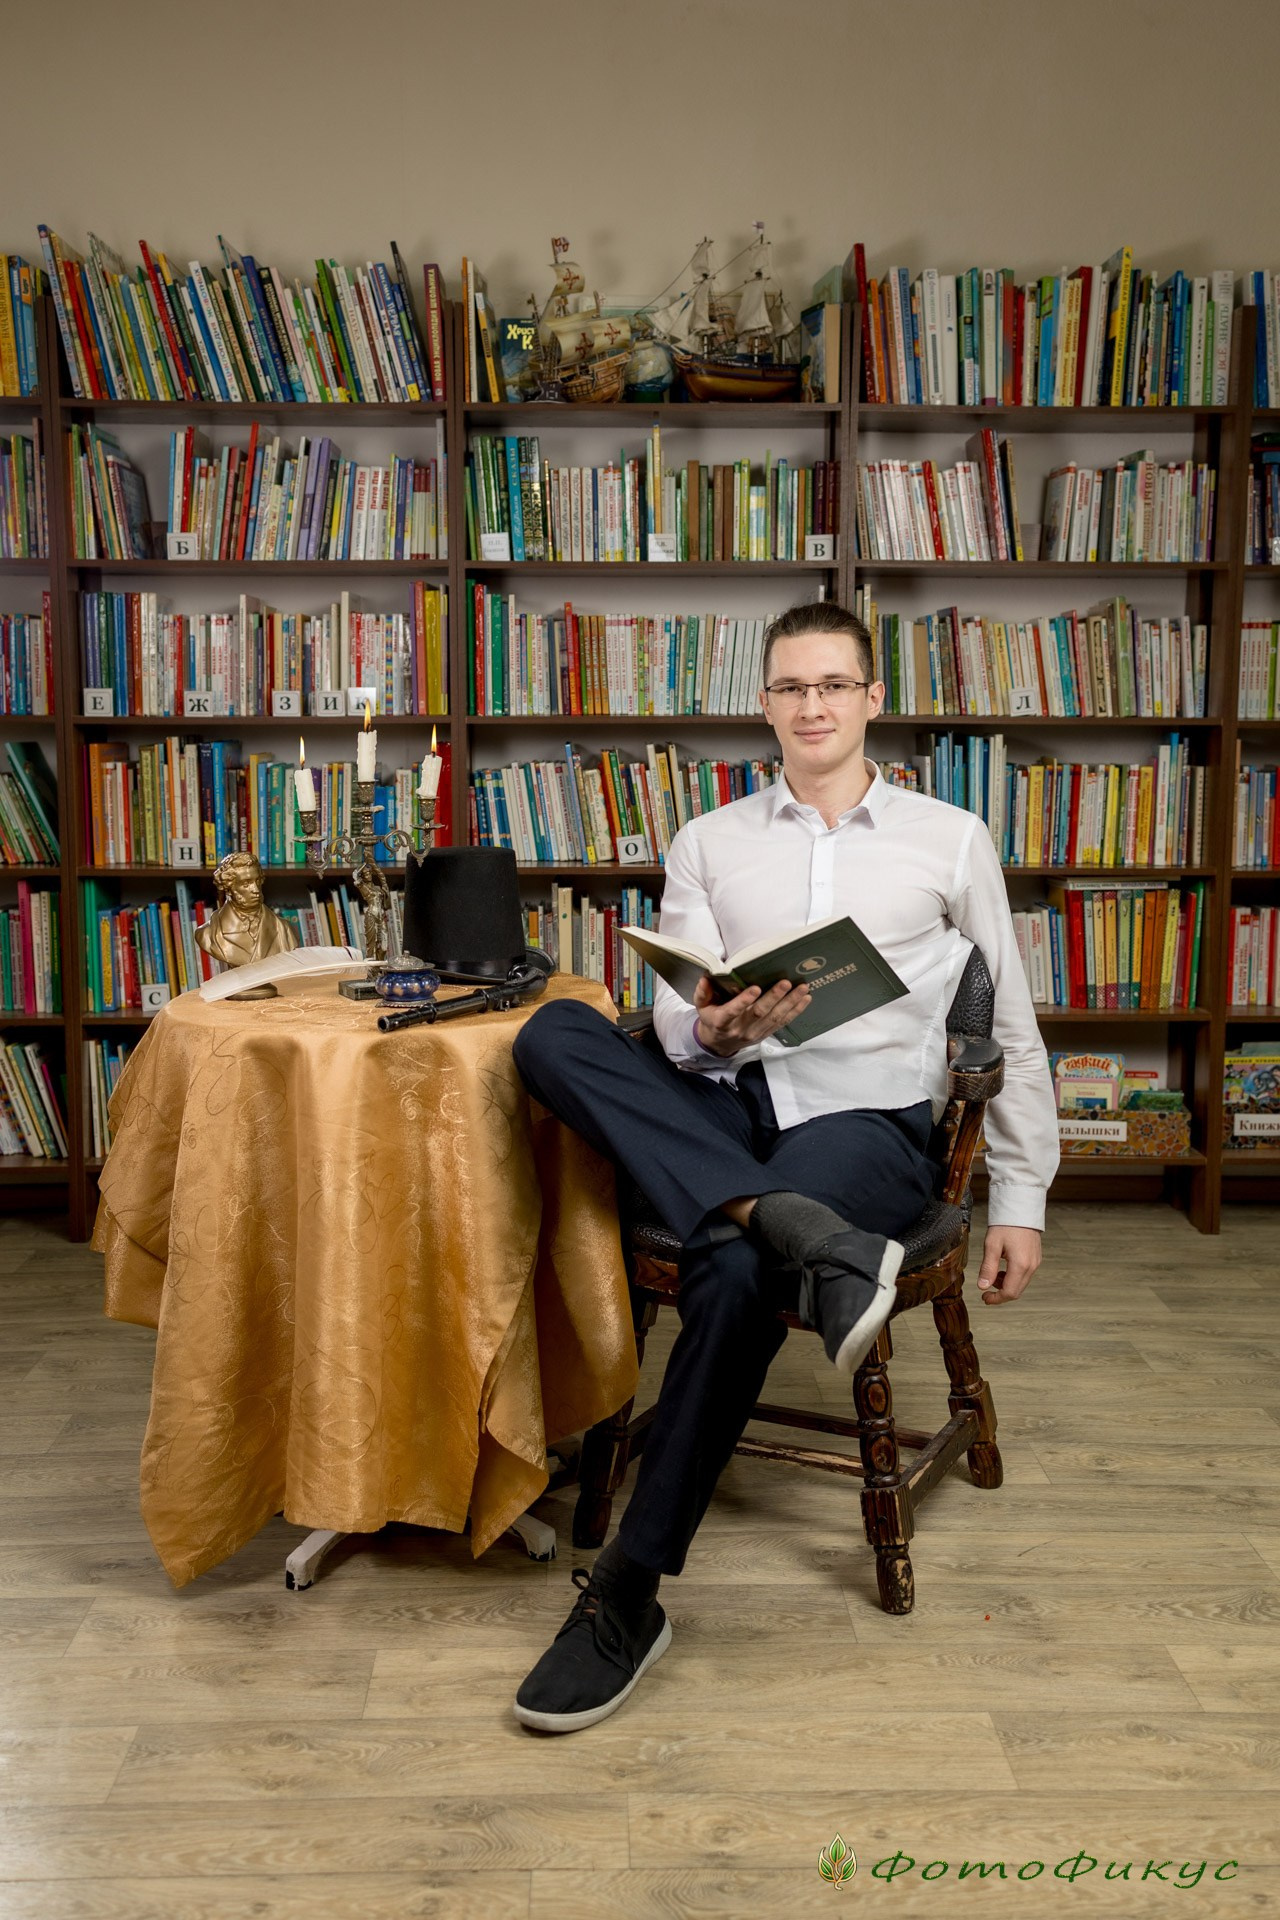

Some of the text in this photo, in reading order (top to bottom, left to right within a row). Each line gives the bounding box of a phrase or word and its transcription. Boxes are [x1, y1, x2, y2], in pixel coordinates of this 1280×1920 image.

[193, 268, 213, 318] ЖИВОТНЫХ
[427, 268, 441, 381] НОВАЯ ЭНЦИКЛОПЕДИЯ ШКОЛЬНИКА
[904, 319, 912, 361] ГЕОГРАФИЯ
[1216, 347, 1226, 370] ВСЁ
[1215, 374, 1225, 404] ХОЧУ
[509, 446, 517, 486] СКАЗЫ
[356, 470, 365, 509] Питер Пэн
[1143, 462, 1153, 509] НОВЫЕ
[370, 486, 378, 509] Питер
[381, 486, 389, 509] Питер
[521, 490, 531, 529] СКАЗЫ
[531, 490, 542, 529] СКАЗЫ
[176, 541, 189, 555] Б
[813, 543, 825, 557] В
[92, 696, 105, 710] Е
[189, 698, 208, 712] Ж
[279, 696, 291, 710] З
[323, 697, 338, 710] И
[1015, 696, 1032, 711] Л
[239, 816, 247, 851] НЕКРАСОВ
[179, 846, 194, 860] Н
[625, 842, 638, 857] О
[149, 991, 161, 1005] С
[1064, 1056, 1107, 1071] гадкий
